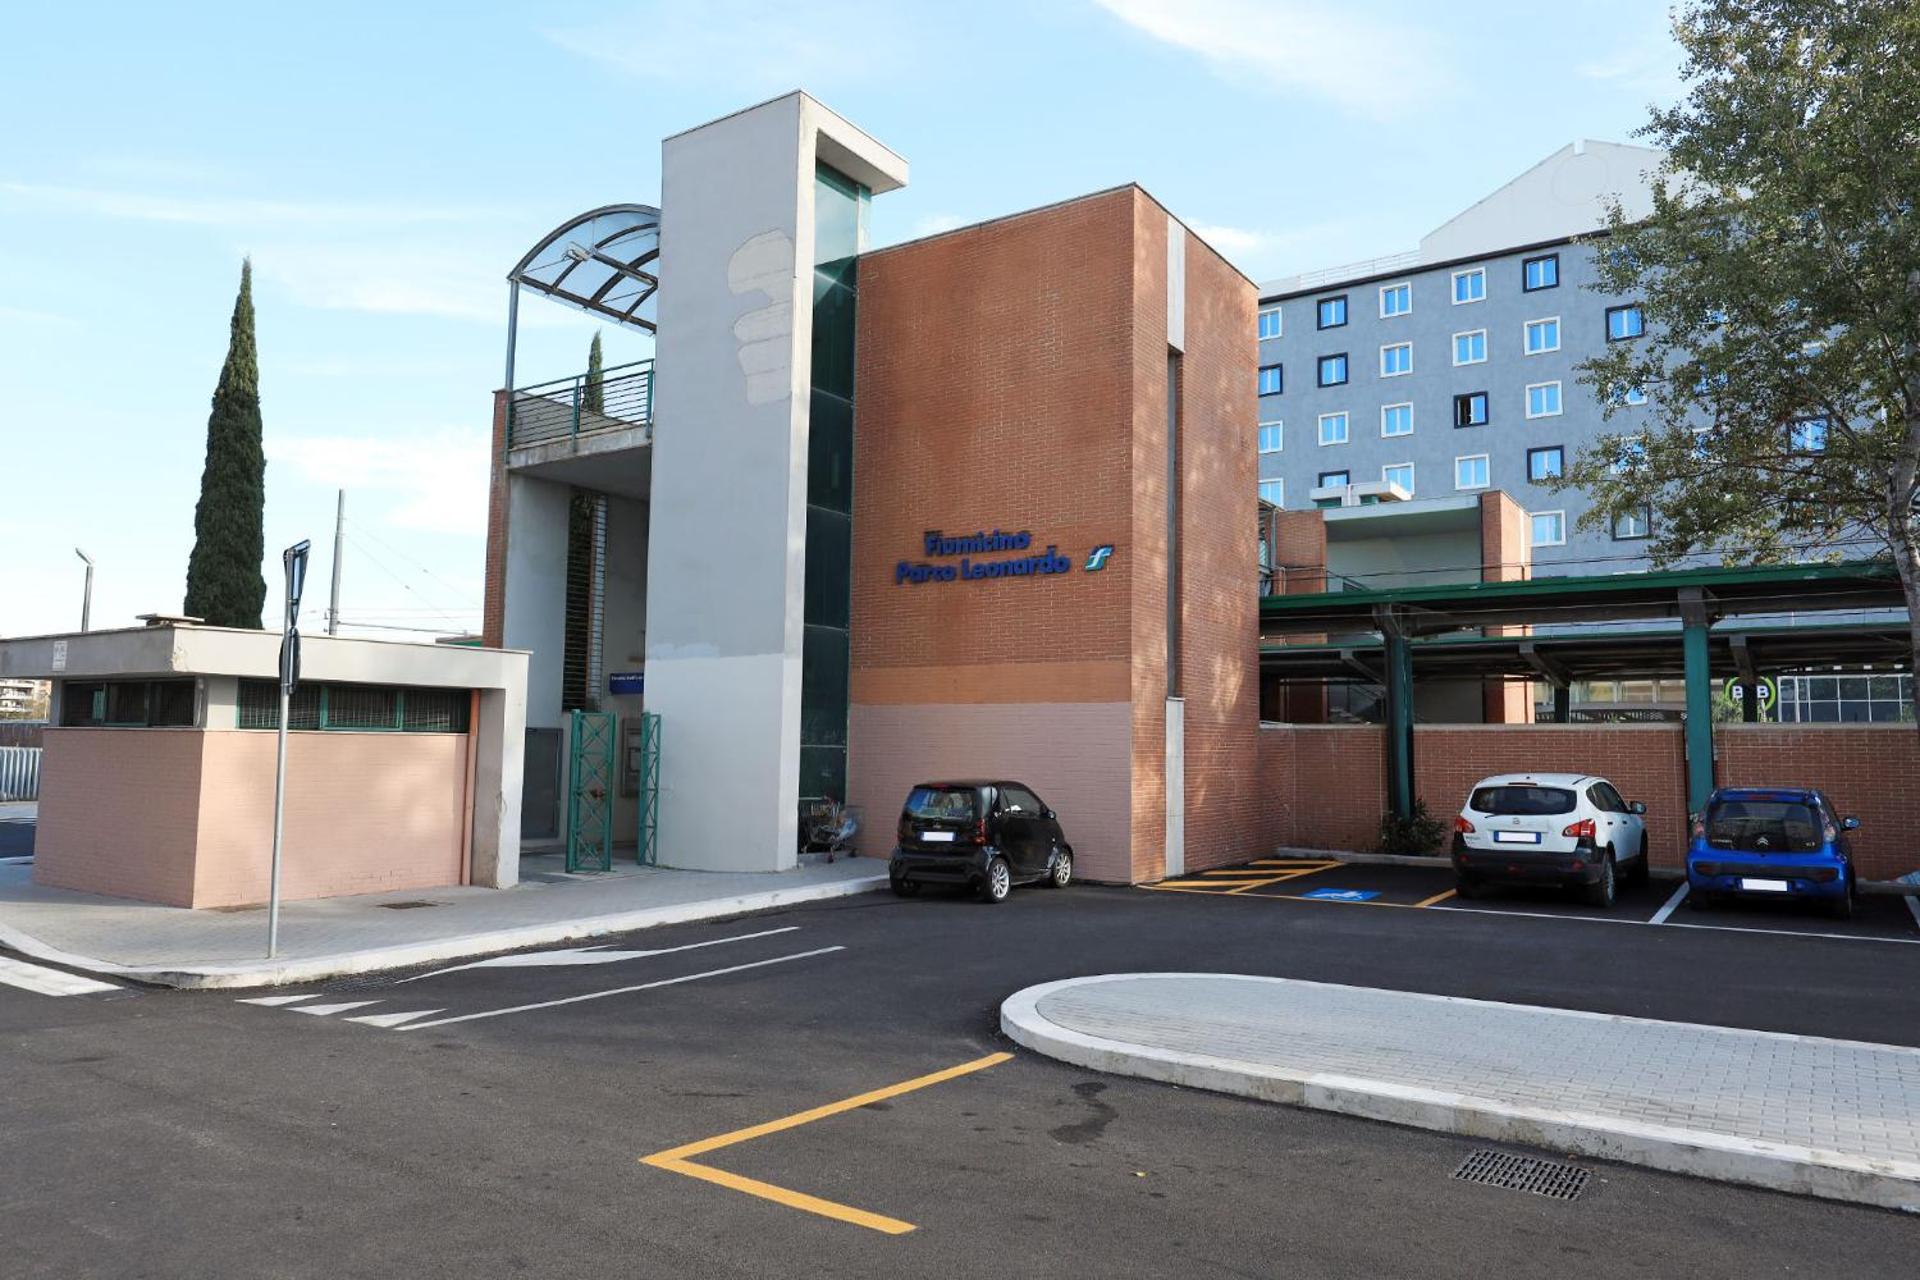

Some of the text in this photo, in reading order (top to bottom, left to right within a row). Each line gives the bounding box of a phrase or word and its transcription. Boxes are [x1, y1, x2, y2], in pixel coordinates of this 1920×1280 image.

[924, 530, 1031, 556] Fiumicino
[896, 545, 1071, 584] Parco Leonardo
[1732, 685, 1769, 699] BB
